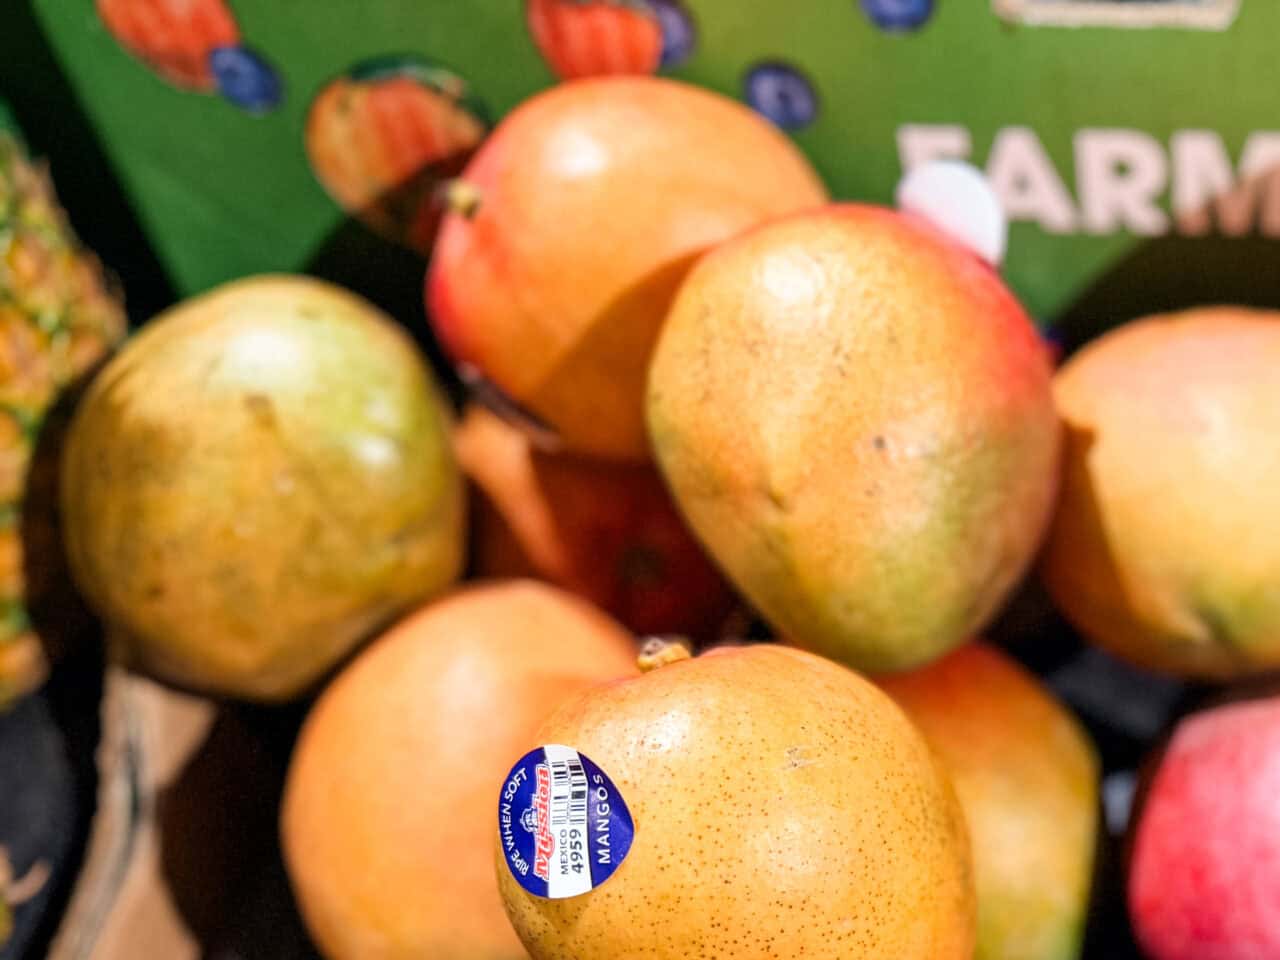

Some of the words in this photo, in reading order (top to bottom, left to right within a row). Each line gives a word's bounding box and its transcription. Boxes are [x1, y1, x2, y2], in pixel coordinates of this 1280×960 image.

[504, 767, 528, 802] SOFT
[502, 803, 515, 851] WHEN
[534, 764, 556, 882] Mission
[593, 774, 611, 864] MANGOS
[511, 849, 530, 876] RIPE
[559, 828, 569, 875] MEXICO
[569, 828, 584, 874] 4959
